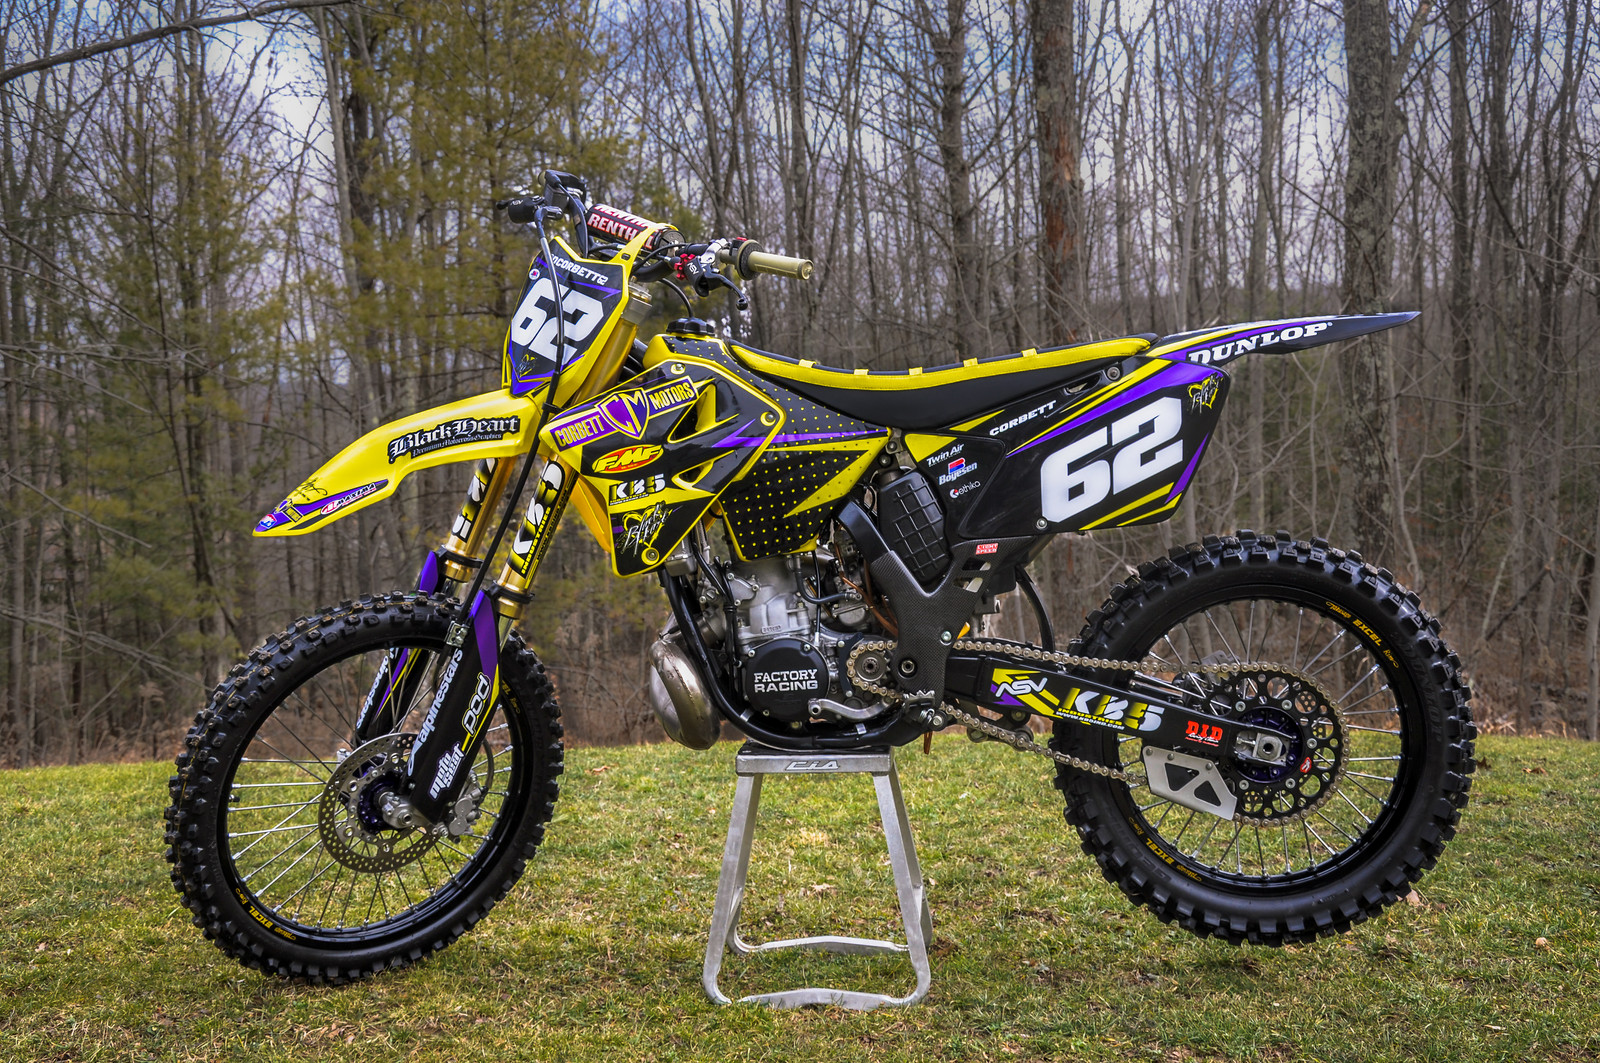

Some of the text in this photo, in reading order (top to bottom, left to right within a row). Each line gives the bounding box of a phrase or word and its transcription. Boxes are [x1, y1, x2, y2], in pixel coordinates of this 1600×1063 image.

[587, 213, 654, 250] RENTHL
[686, 262, 700, 274] ASV
[511, 277, 604, 366] 62
[1188, 322, 1327, 365] DUNLOP
[649, 382, 695, 411] MOTORS
[603, 390, 646, 436] CM
[989, 400, 1056, 436] CORBETT
[554, 414, 605, 448] CORBETT
[593, 444, 663, 473] FMF
[926, 450, 950, 466] Twin
[949, 444, 965, 456] Air
[1040, 396, 1183, 523] 62
[939, 462, 978, 486] Boyesen
[958, 480, 981, 495] ethika
[520, 506, 551, 575] INDUSTRIES
[1352, 619, 1383, 647] EXCEL
[754, 668, 818, 683] FACTORY
[754, 680, 818, 693] RACING
[995, 677, 1048, 697] ASV
[418, 648, 463, 743] alpinestars
[463, 674, 490, 736] pod
[1061, 687, 1165, 732] KB5
[1057, 707, 1124, 727] INDUSTRIES
[1146, 838, 1176, 865] EXCEL
[249, 906, 274, 929] EXCEL
